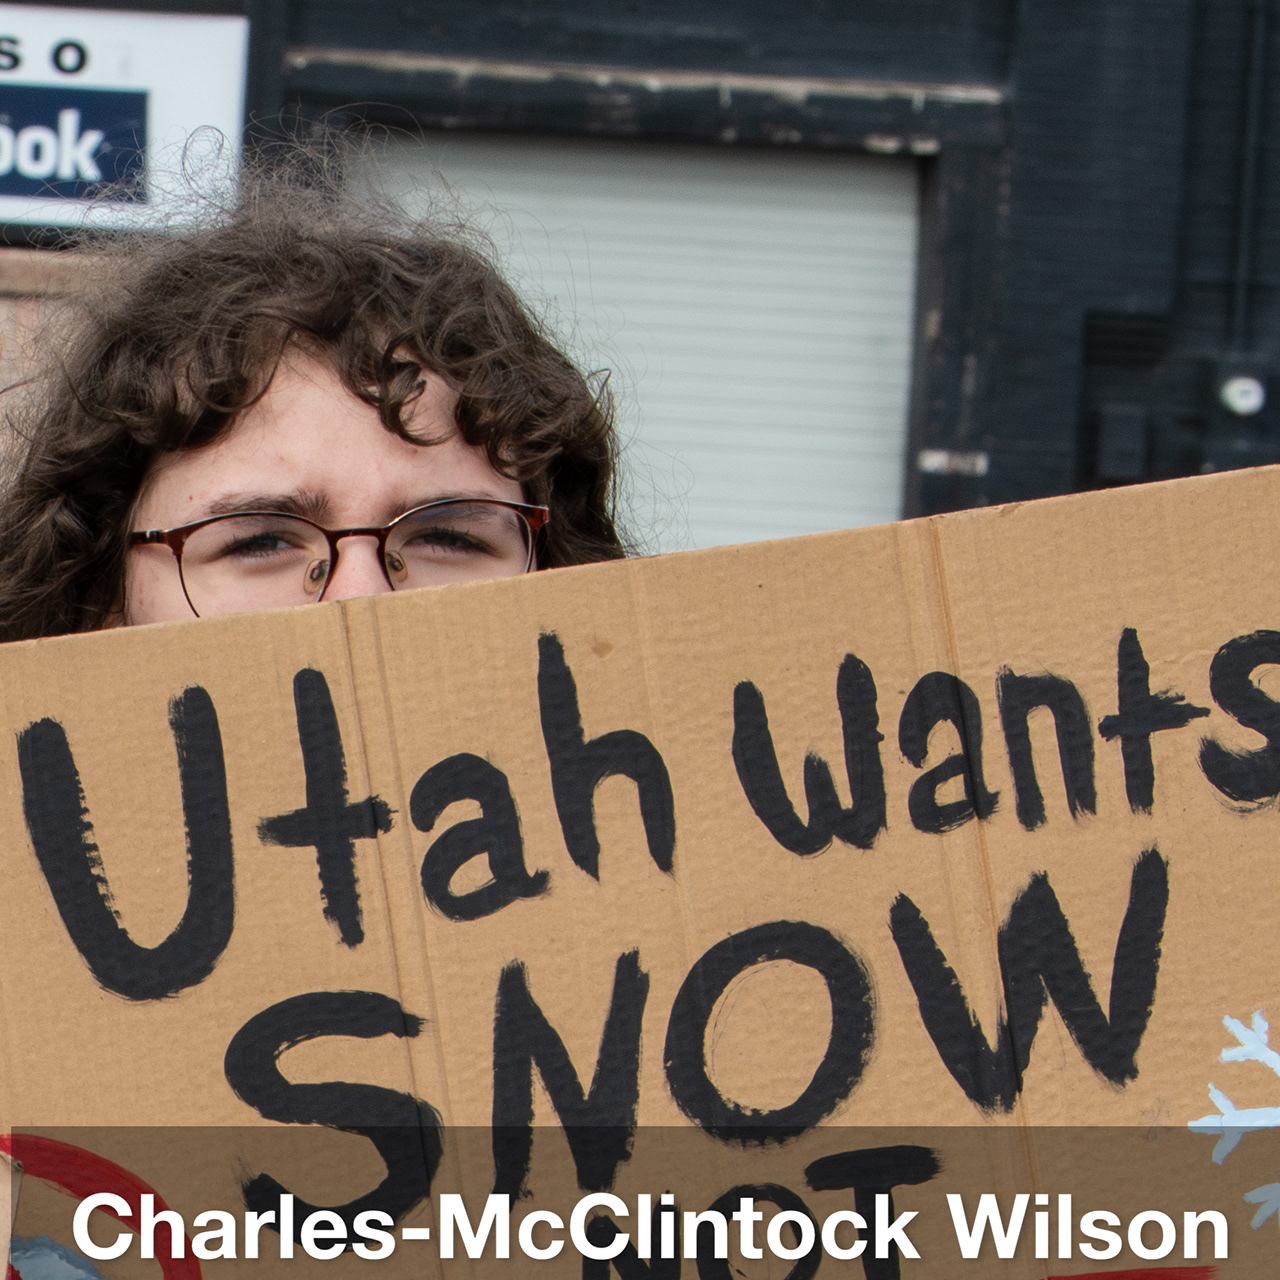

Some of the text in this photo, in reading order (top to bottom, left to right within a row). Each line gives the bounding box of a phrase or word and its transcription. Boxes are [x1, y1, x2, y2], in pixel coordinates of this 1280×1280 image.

[51, 40, 89, 74] o
[15, 629, 677, 1001] Utah
[224, 846, 1169, 1252] SNOW
